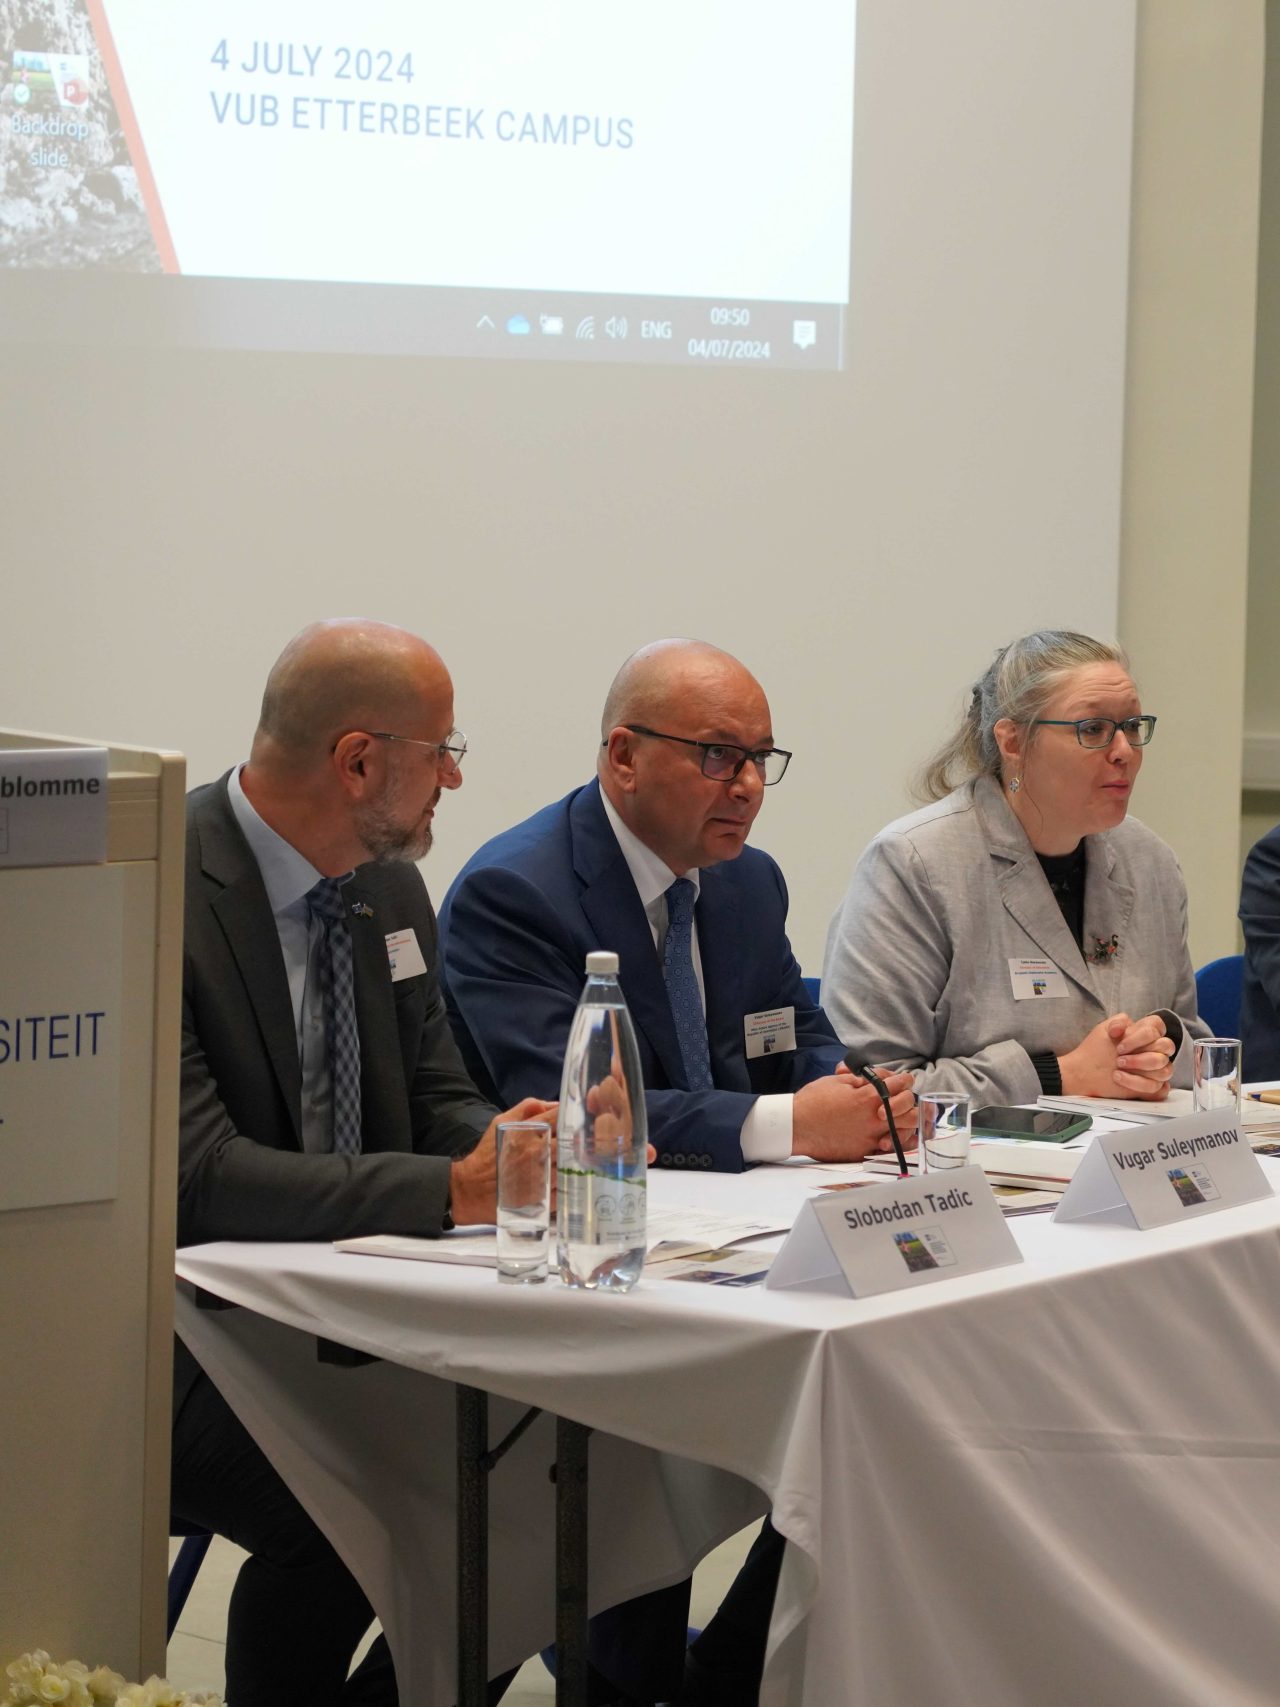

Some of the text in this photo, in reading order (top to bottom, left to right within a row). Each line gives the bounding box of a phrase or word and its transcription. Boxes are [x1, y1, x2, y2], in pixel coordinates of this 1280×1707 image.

[210, 38, 414, 83] 4 JULY 2024
[11, 113, 89, 140] Backdrop
[210, 91, 634, 149] VUB ETTERBEEK CAMPUS
[31, 148, 69, 167] slide
[641, 320, 672, 339] ENG
[710, 307, 750, 326] 09:50
[688, 339, 771, 359] 04/07/2024
[1113, 1129, 1240, 1171] Vugar Suleymanov
[844, 1189, 973, 1229] Slobodan Tadic
